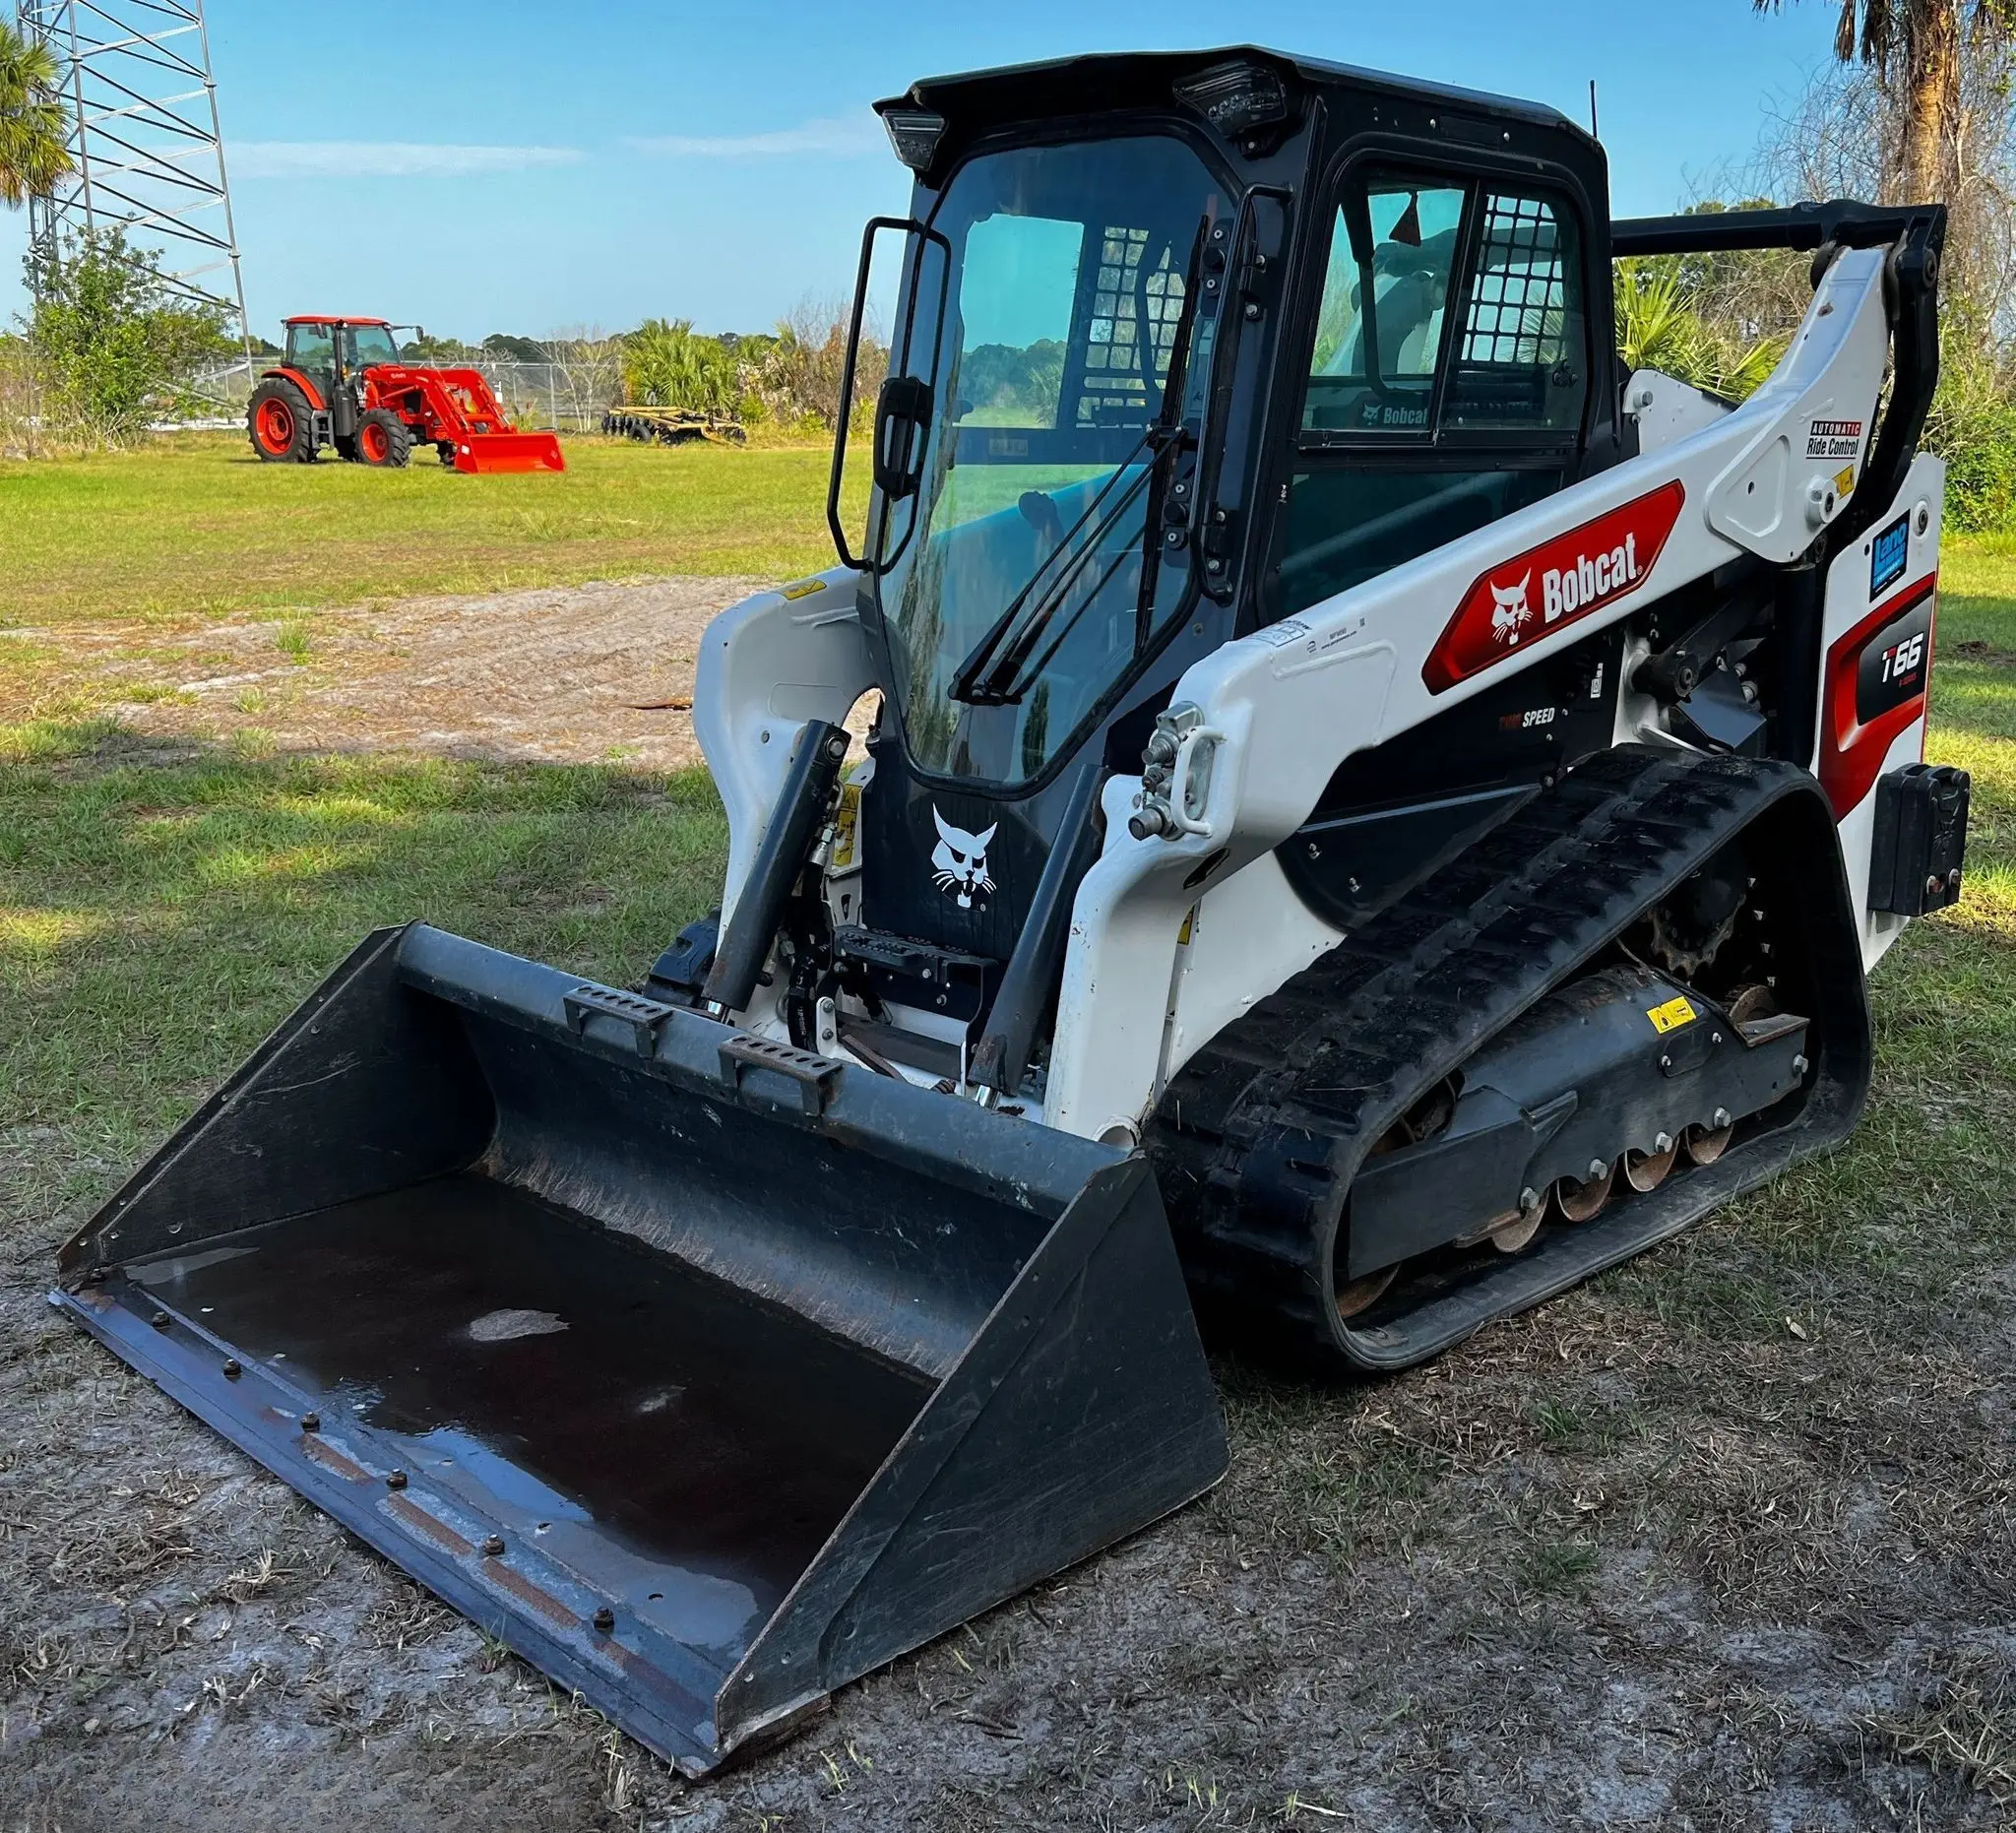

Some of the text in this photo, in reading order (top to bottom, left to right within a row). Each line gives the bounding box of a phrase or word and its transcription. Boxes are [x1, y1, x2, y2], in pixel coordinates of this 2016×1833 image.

[1383, 407, 1428, 424] Bobcat
[1812, 422, 1860, 435] AUTOMATIC
[1806, 438, 1858, 455] Ride Control
[1875, 523, 1908, 563] Lano
[1543, 533, 1637, 624] Bobcat
[1882, 633, 1924, 682] T66
[1522, 708, 1555, 727] SPEED
